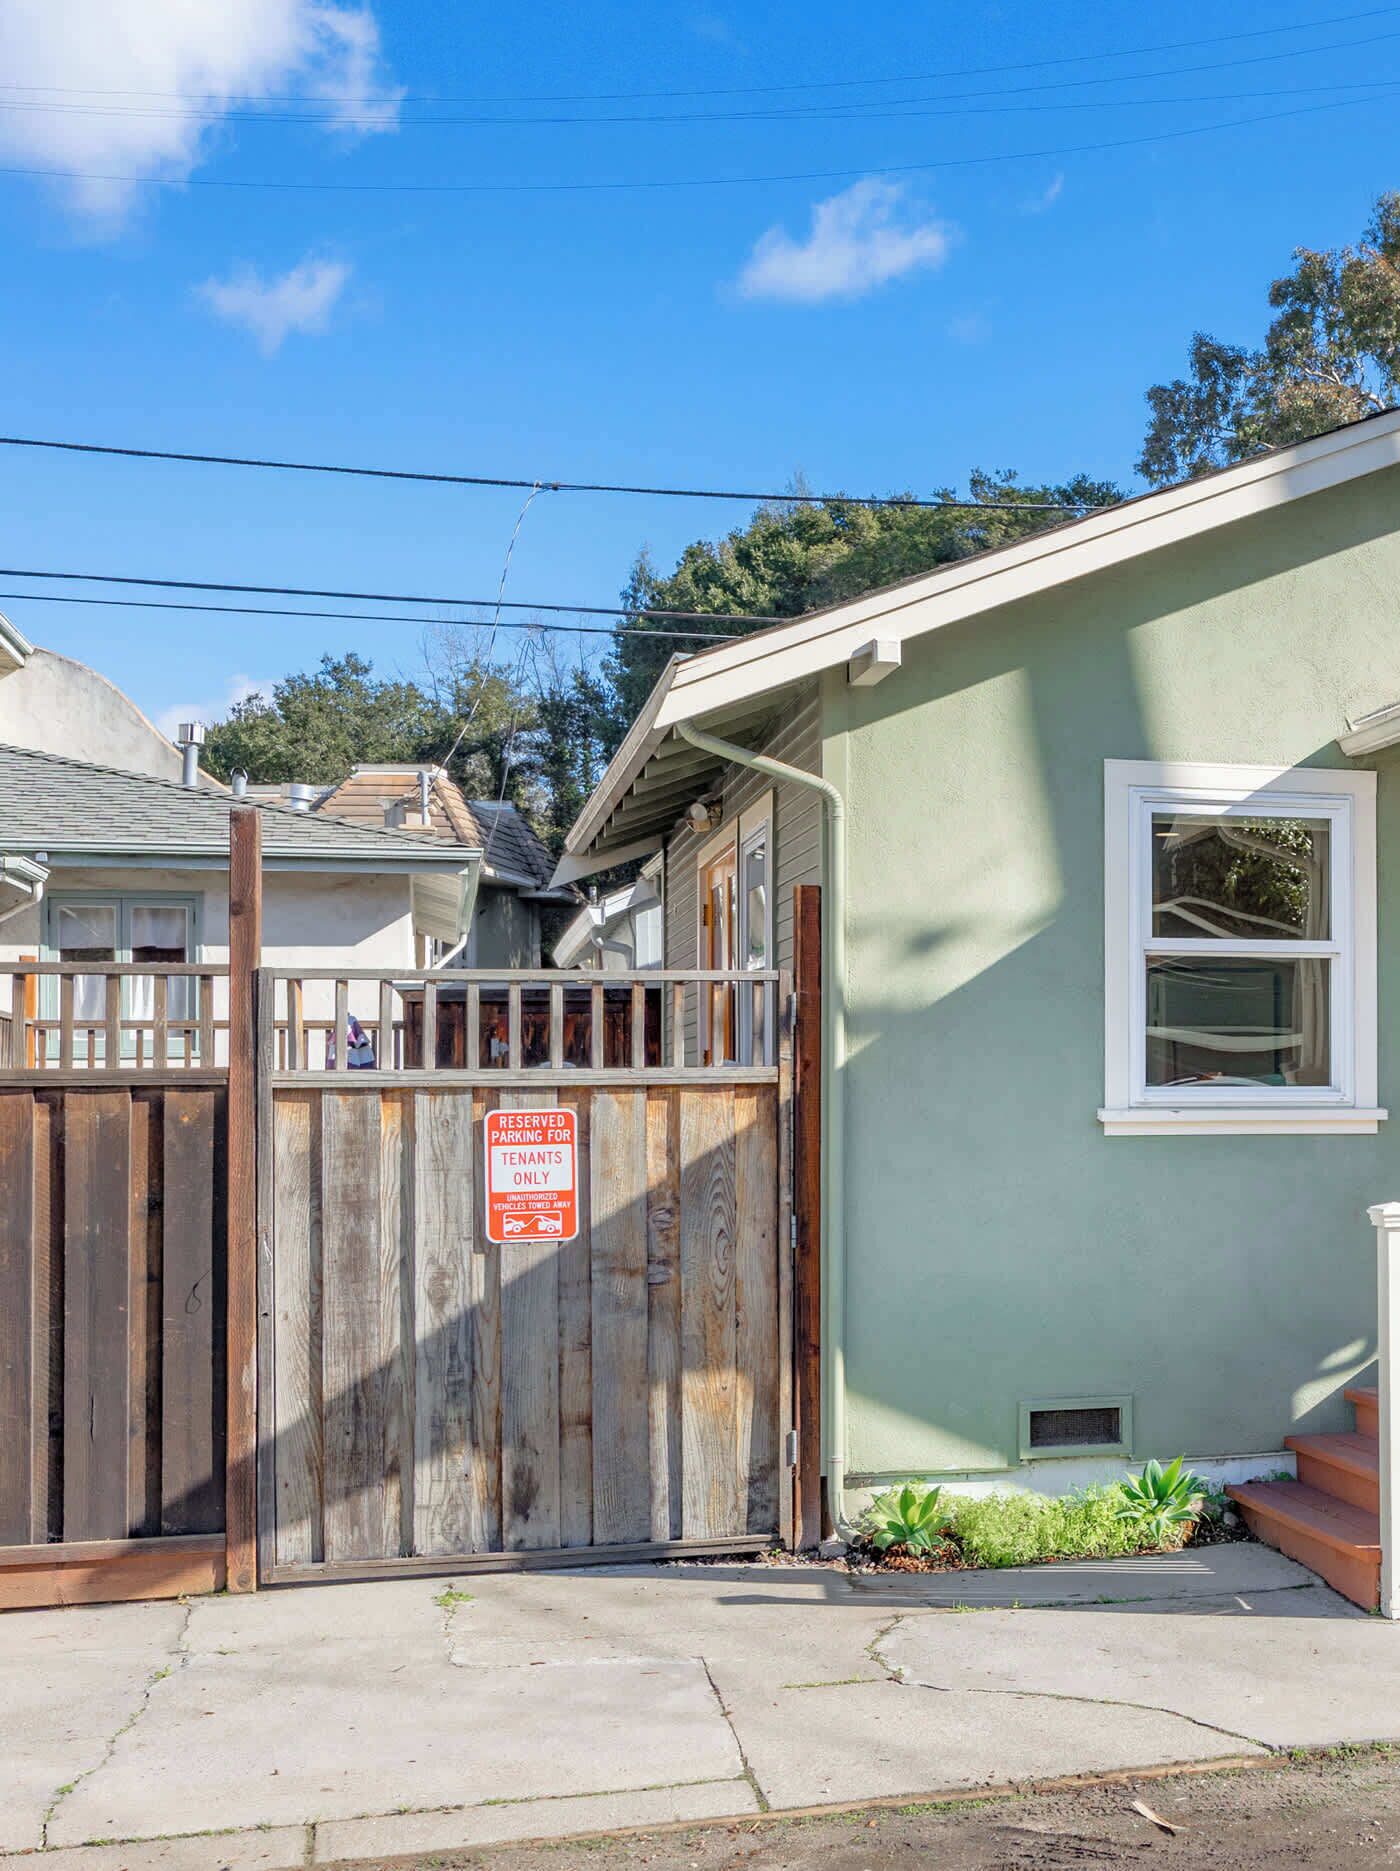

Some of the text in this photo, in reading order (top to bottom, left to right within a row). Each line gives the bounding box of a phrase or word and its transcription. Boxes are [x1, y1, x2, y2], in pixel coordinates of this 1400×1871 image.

[500, 1115, 565, 1128] RESERVED
[492, 1129, 571, 1143] PARKING FOR
[501, 1151, 562, 1165] TENANTS
[514, 1171, 550, 1185] ONLY
[507, 1193, 558, 1201] UNAUTHORIZED
[493, 1200, 571, 1210] VEHICLES TOWED AWAY
